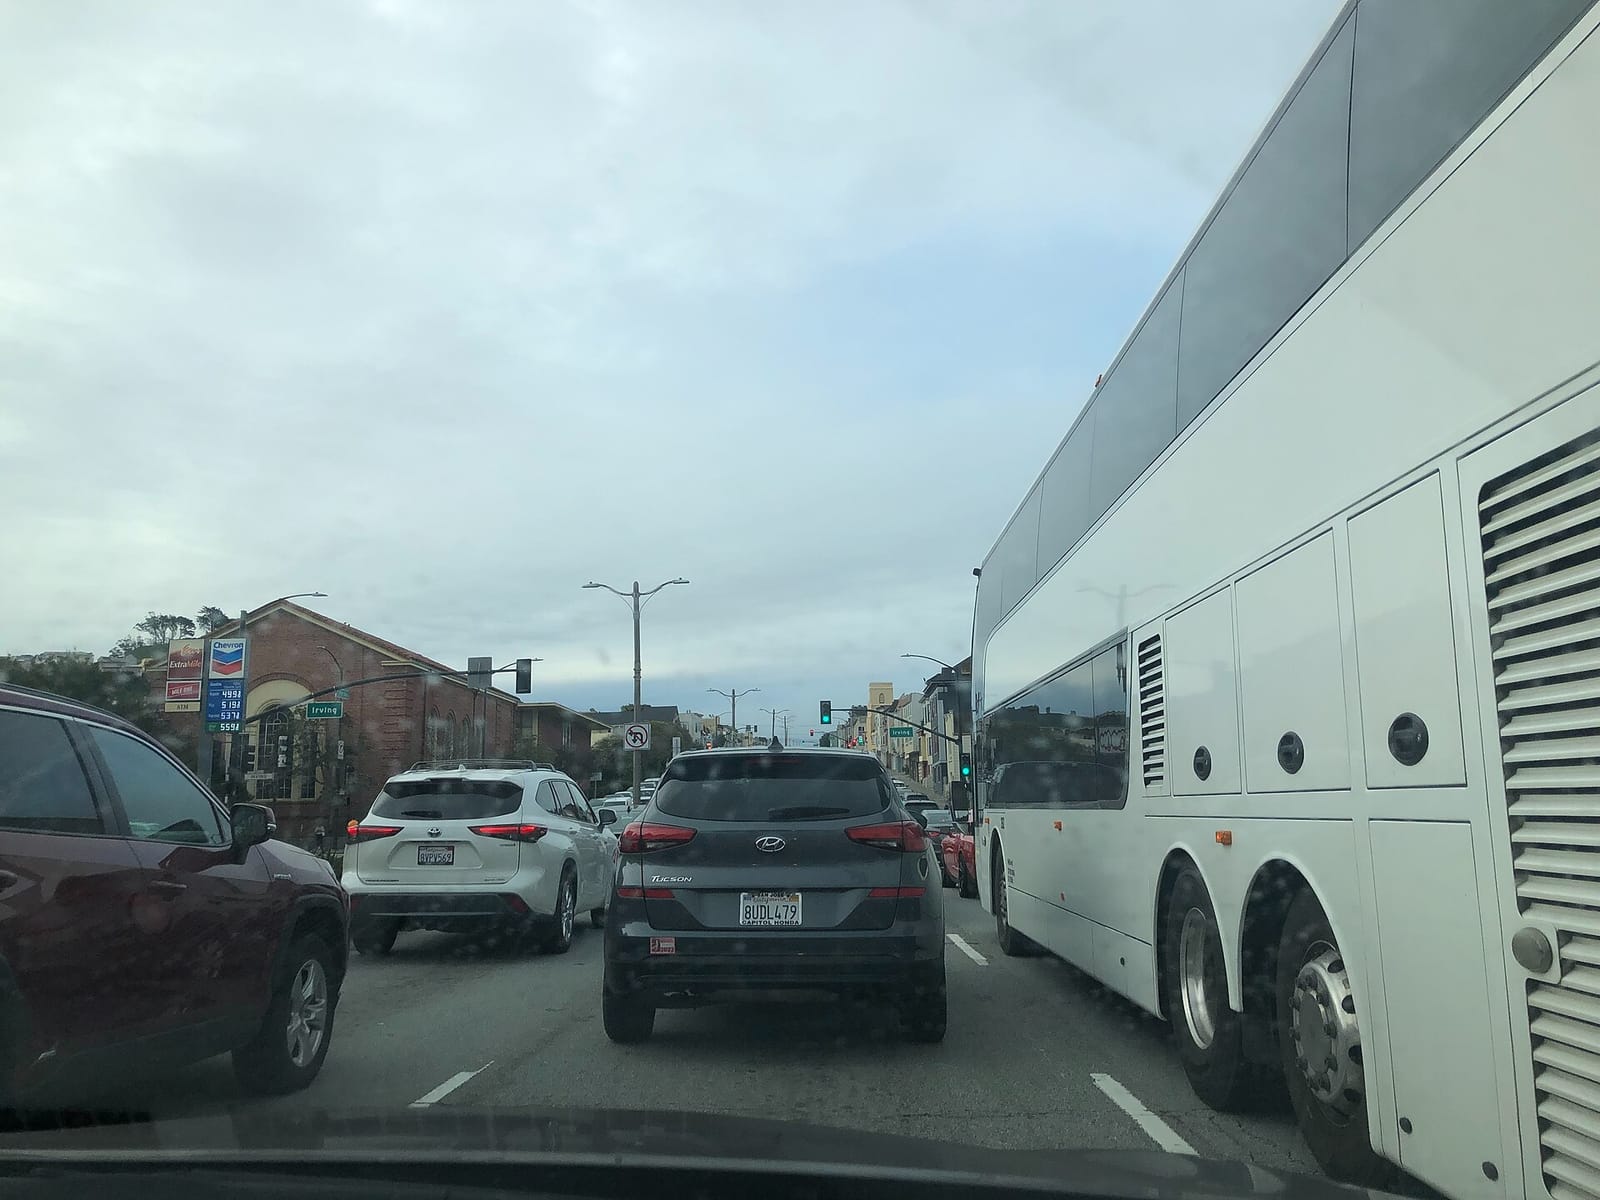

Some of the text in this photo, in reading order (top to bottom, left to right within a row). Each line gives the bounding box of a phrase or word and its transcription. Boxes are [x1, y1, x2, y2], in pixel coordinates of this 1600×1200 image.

[213, 641, 244, 649] Chevron
[169, 659, 201, 668] ExtraMile
[311, 706, 337, 714] Irving
[744, 904, 797, 920] 8UDL479
